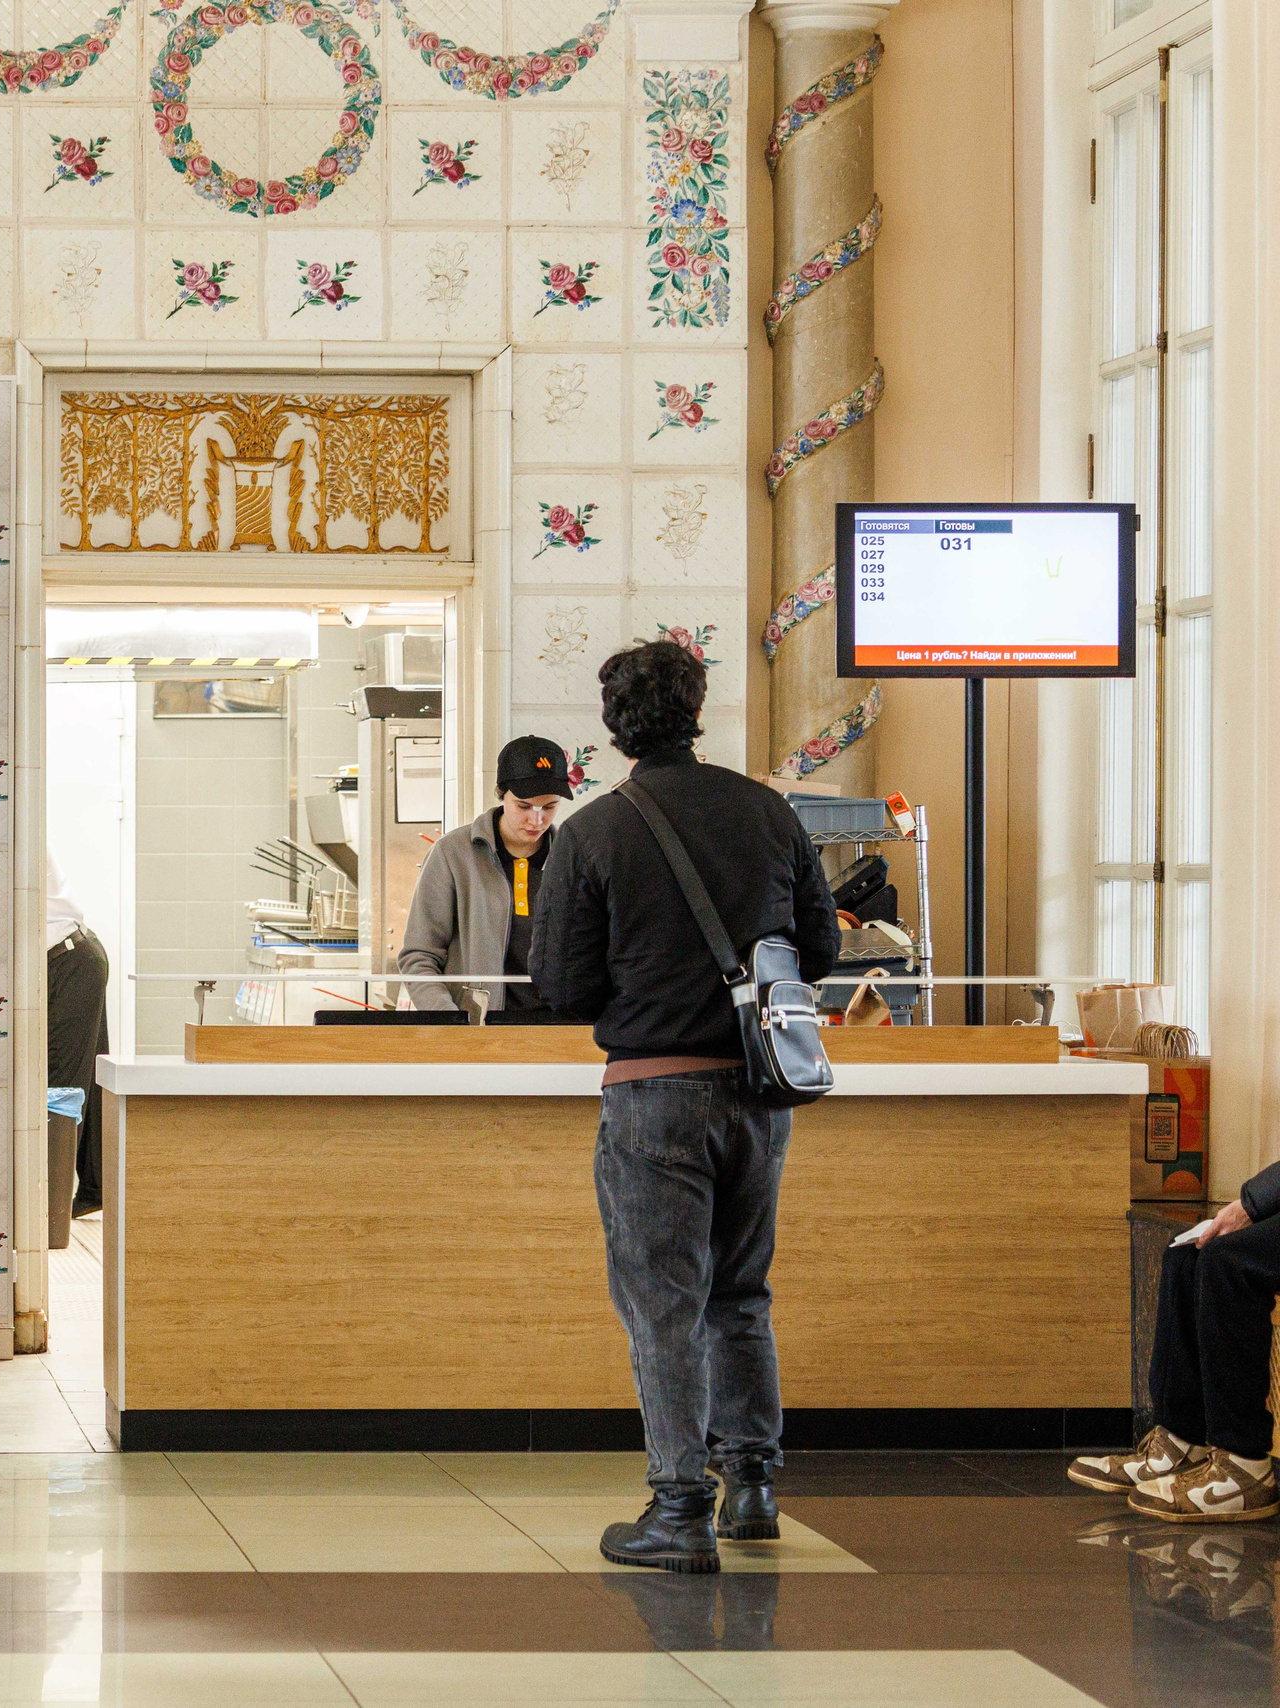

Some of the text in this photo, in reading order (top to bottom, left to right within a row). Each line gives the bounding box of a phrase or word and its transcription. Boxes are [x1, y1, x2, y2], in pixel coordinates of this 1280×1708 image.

[860, 521, 910, 531] Готовятся
[939, 521, 975, 531] Готовы
[861, 536, 885, 546] 025
[940, 537, 972, 551] 031
[861, 550, 885, 560] 027
[861, 564, 885, 574] 029
[861, 578, 885, 588] 033
[861, 592, 885, 602] 034
[896, 651, 922, 661] Цена
[932, 650, 968, 662] рубль?
[970, 650, 1002, 661] Найди
[1012, 650, 1077, 662] приложении!
